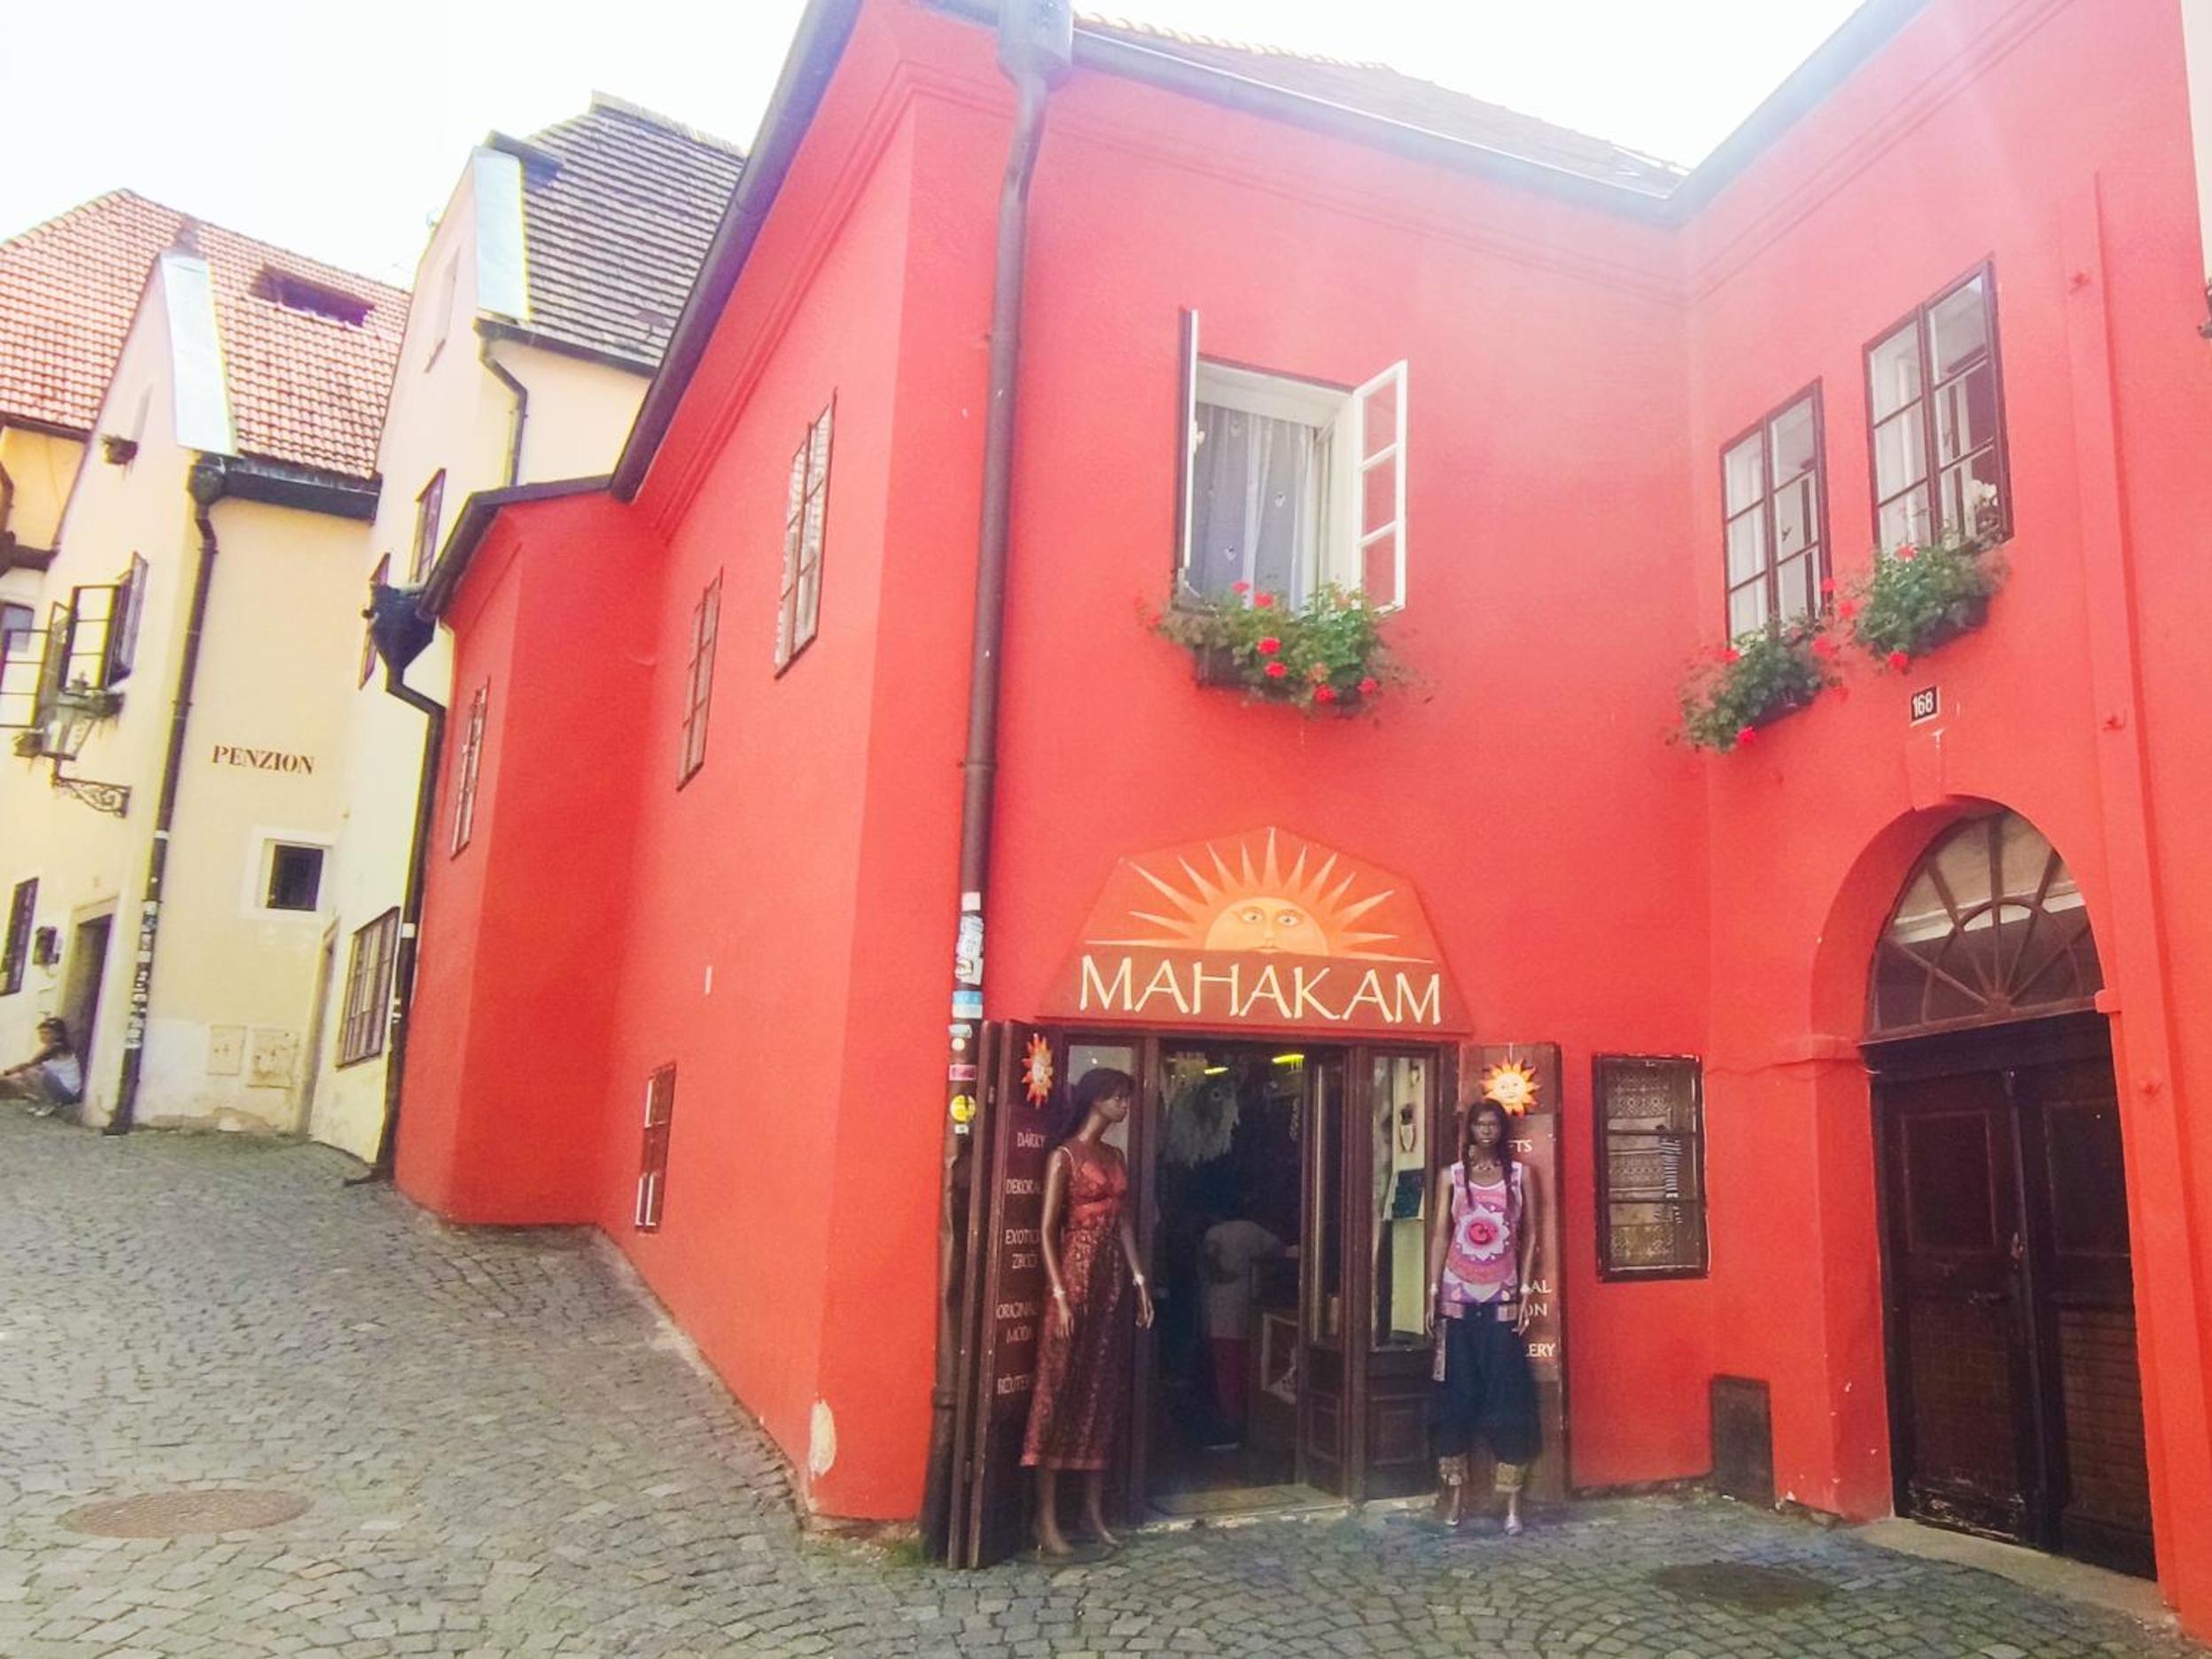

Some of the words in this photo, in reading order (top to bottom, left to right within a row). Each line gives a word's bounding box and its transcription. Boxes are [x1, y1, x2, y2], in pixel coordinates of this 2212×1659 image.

[1912, 690, 1934, 718] 168
[212, 744, 314, 775] PENZION
[1079, 954, 1442, 1025] MAHAKAM
